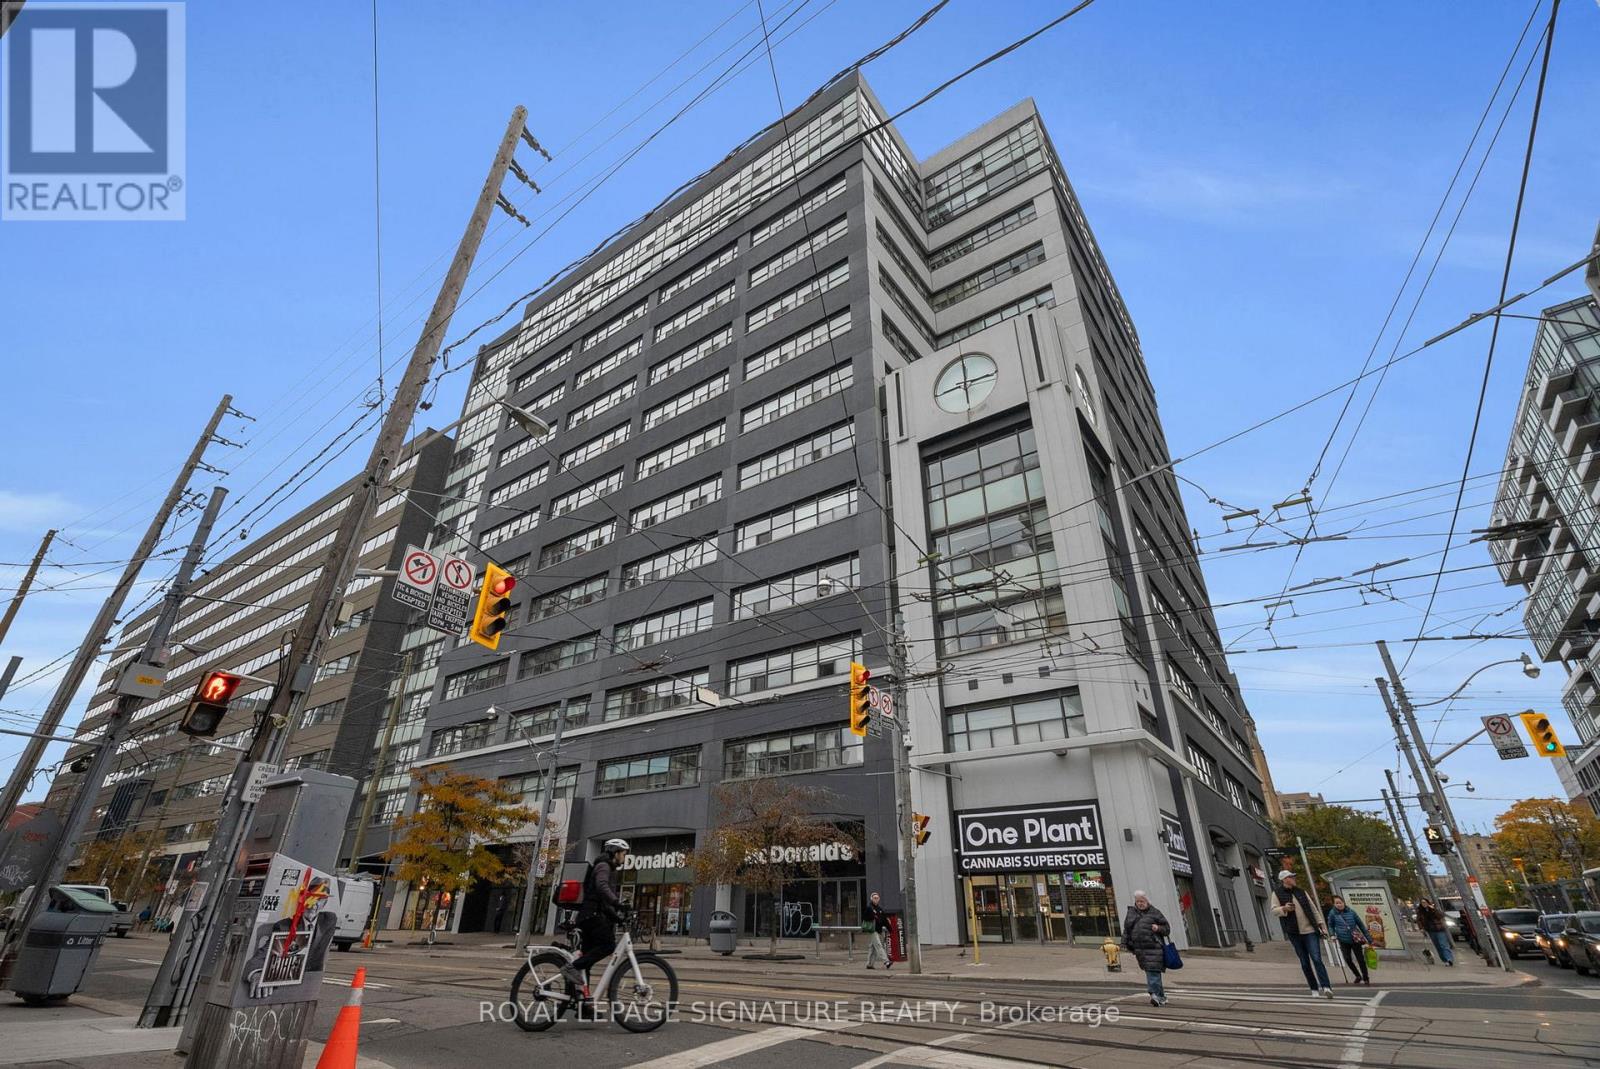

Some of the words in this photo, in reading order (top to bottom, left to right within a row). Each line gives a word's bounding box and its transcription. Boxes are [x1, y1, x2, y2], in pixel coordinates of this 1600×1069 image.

[397, 582, 406, 592] TTC
[410, 588, 432, 601] BICYCLES
[439, 584, 470, 600] AUTHORIZED
[441, 592, 465, 605] VEHICLES
[396, 592, 426, 608] EXCEPTED
[436, 596, 447, 604] AND
[447, 599, 468, 611] BICYCLES
[437, 603, 463, 617] EXCEPTED
[444, 613, 466, 626] EXCEPTED
[966, 821, 1019, 847] One
[1023, 815, 1094, 844] Plant
[616, 851, 686, 871] Donald's
[961, 856, 1022, 870] CANNABIS
[1023, 853, 1106, 868] SUPERSTORE
